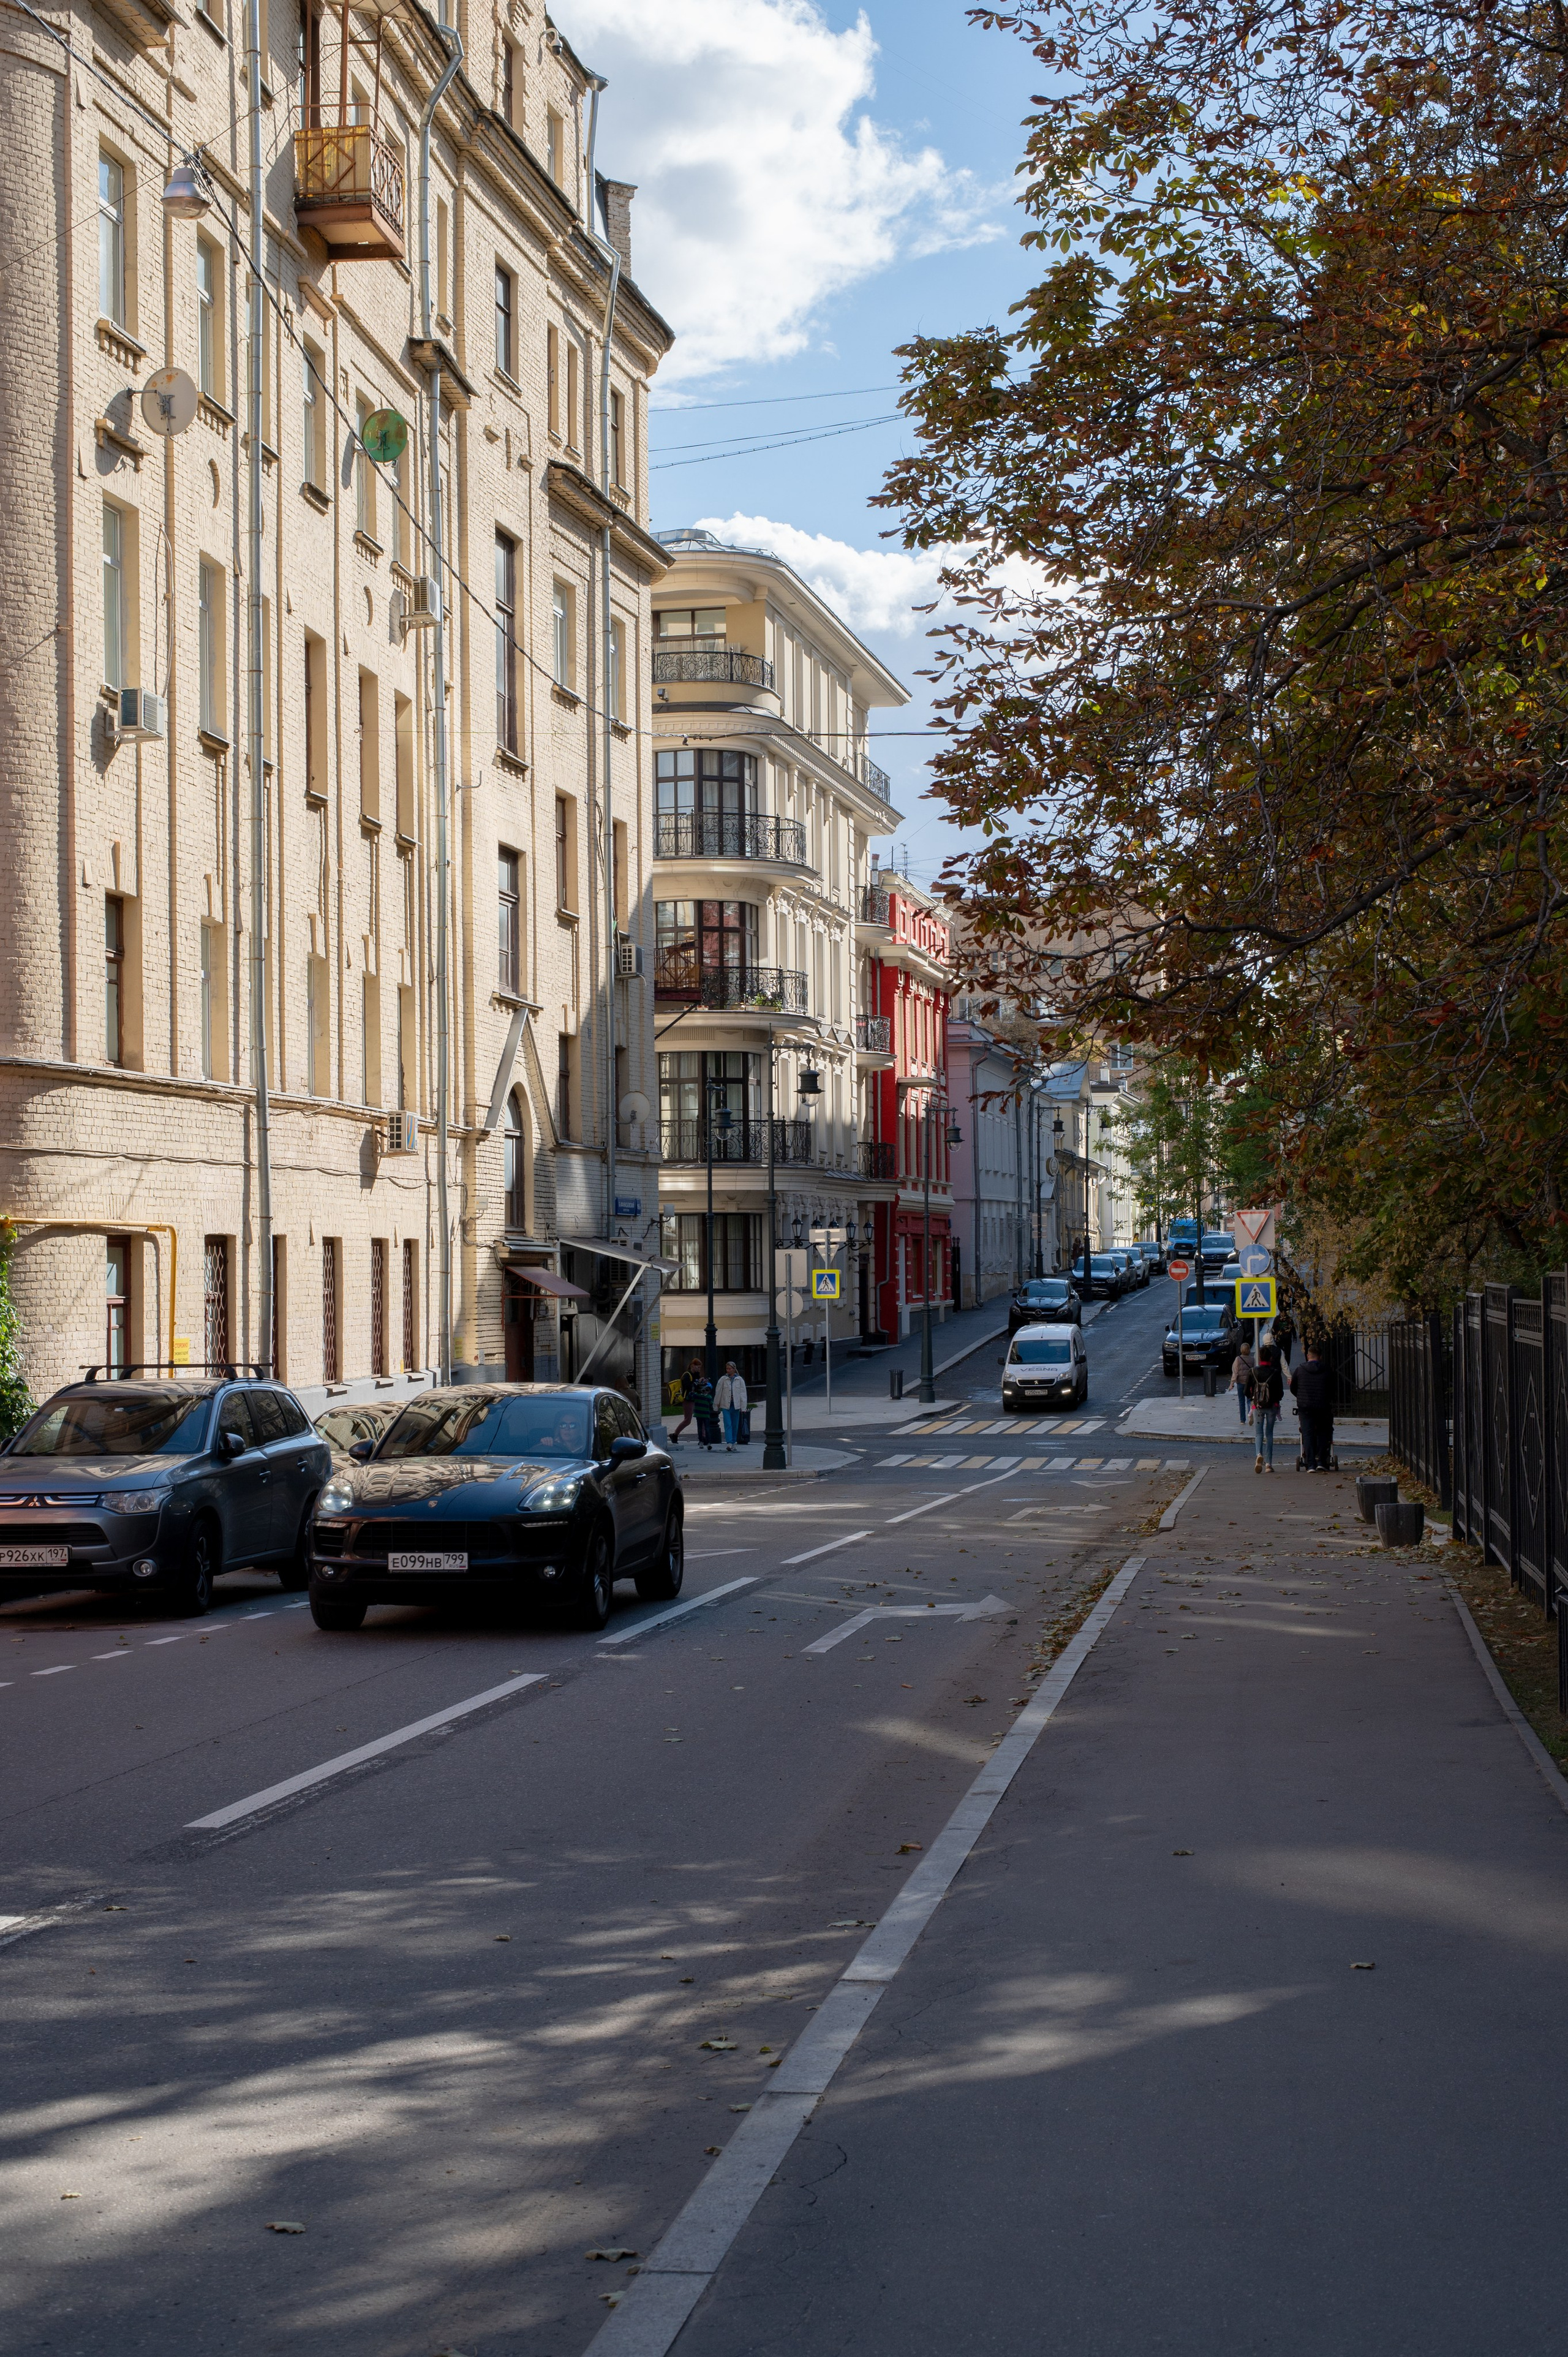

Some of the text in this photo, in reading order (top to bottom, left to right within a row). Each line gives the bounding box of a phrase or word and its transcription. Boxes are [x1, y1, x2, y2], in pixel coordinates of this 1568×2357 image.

[47, 1548, 64, 1558] 197
[393, 1554, 464, 1568] Е099НВ 799
